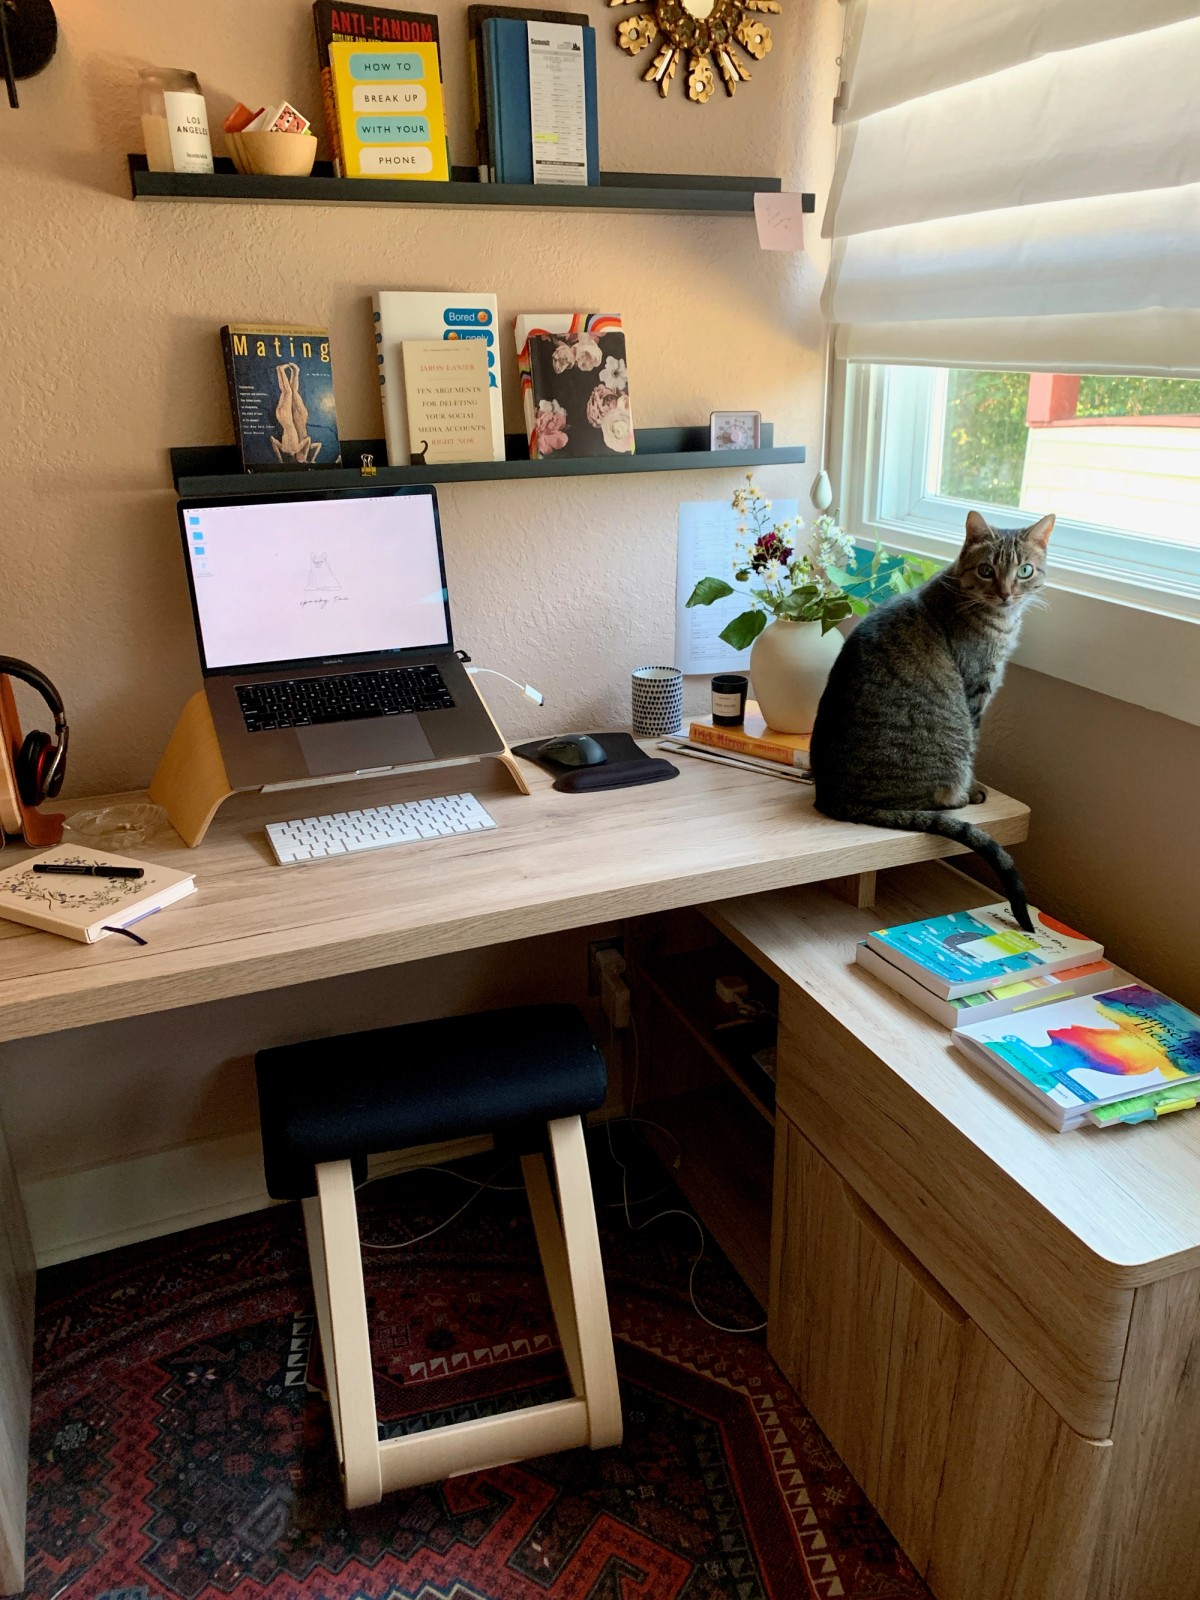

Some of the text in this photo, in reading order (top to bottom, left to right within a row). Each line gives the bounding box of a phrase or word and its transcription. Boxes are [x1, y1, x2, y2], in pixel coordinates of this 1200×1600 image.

[331, 9, 432, 42] ANTI-FANDOM
[364, 62, 411, 71] HOW TO
[364, 94, 418, 102] BREAK UP
[186, 116, 201, 124] LOS
[176, 125, 208, 135] ANGELES
[361, 125, 425, 134] WITH YOUR
[378, 156, 416, 164] PHONE
[448, 311, 475, 322] Bored
[233, 334, 330, 363] Mating
[434, 386, 482, 394] ARGUMENTS
[439, 399, 478, 407] DELETING
[694, 728, 714, 743] Trick
[717, 732, 747, 751] Mirror
[1132, 1019, 1195, 1060] Therapy
